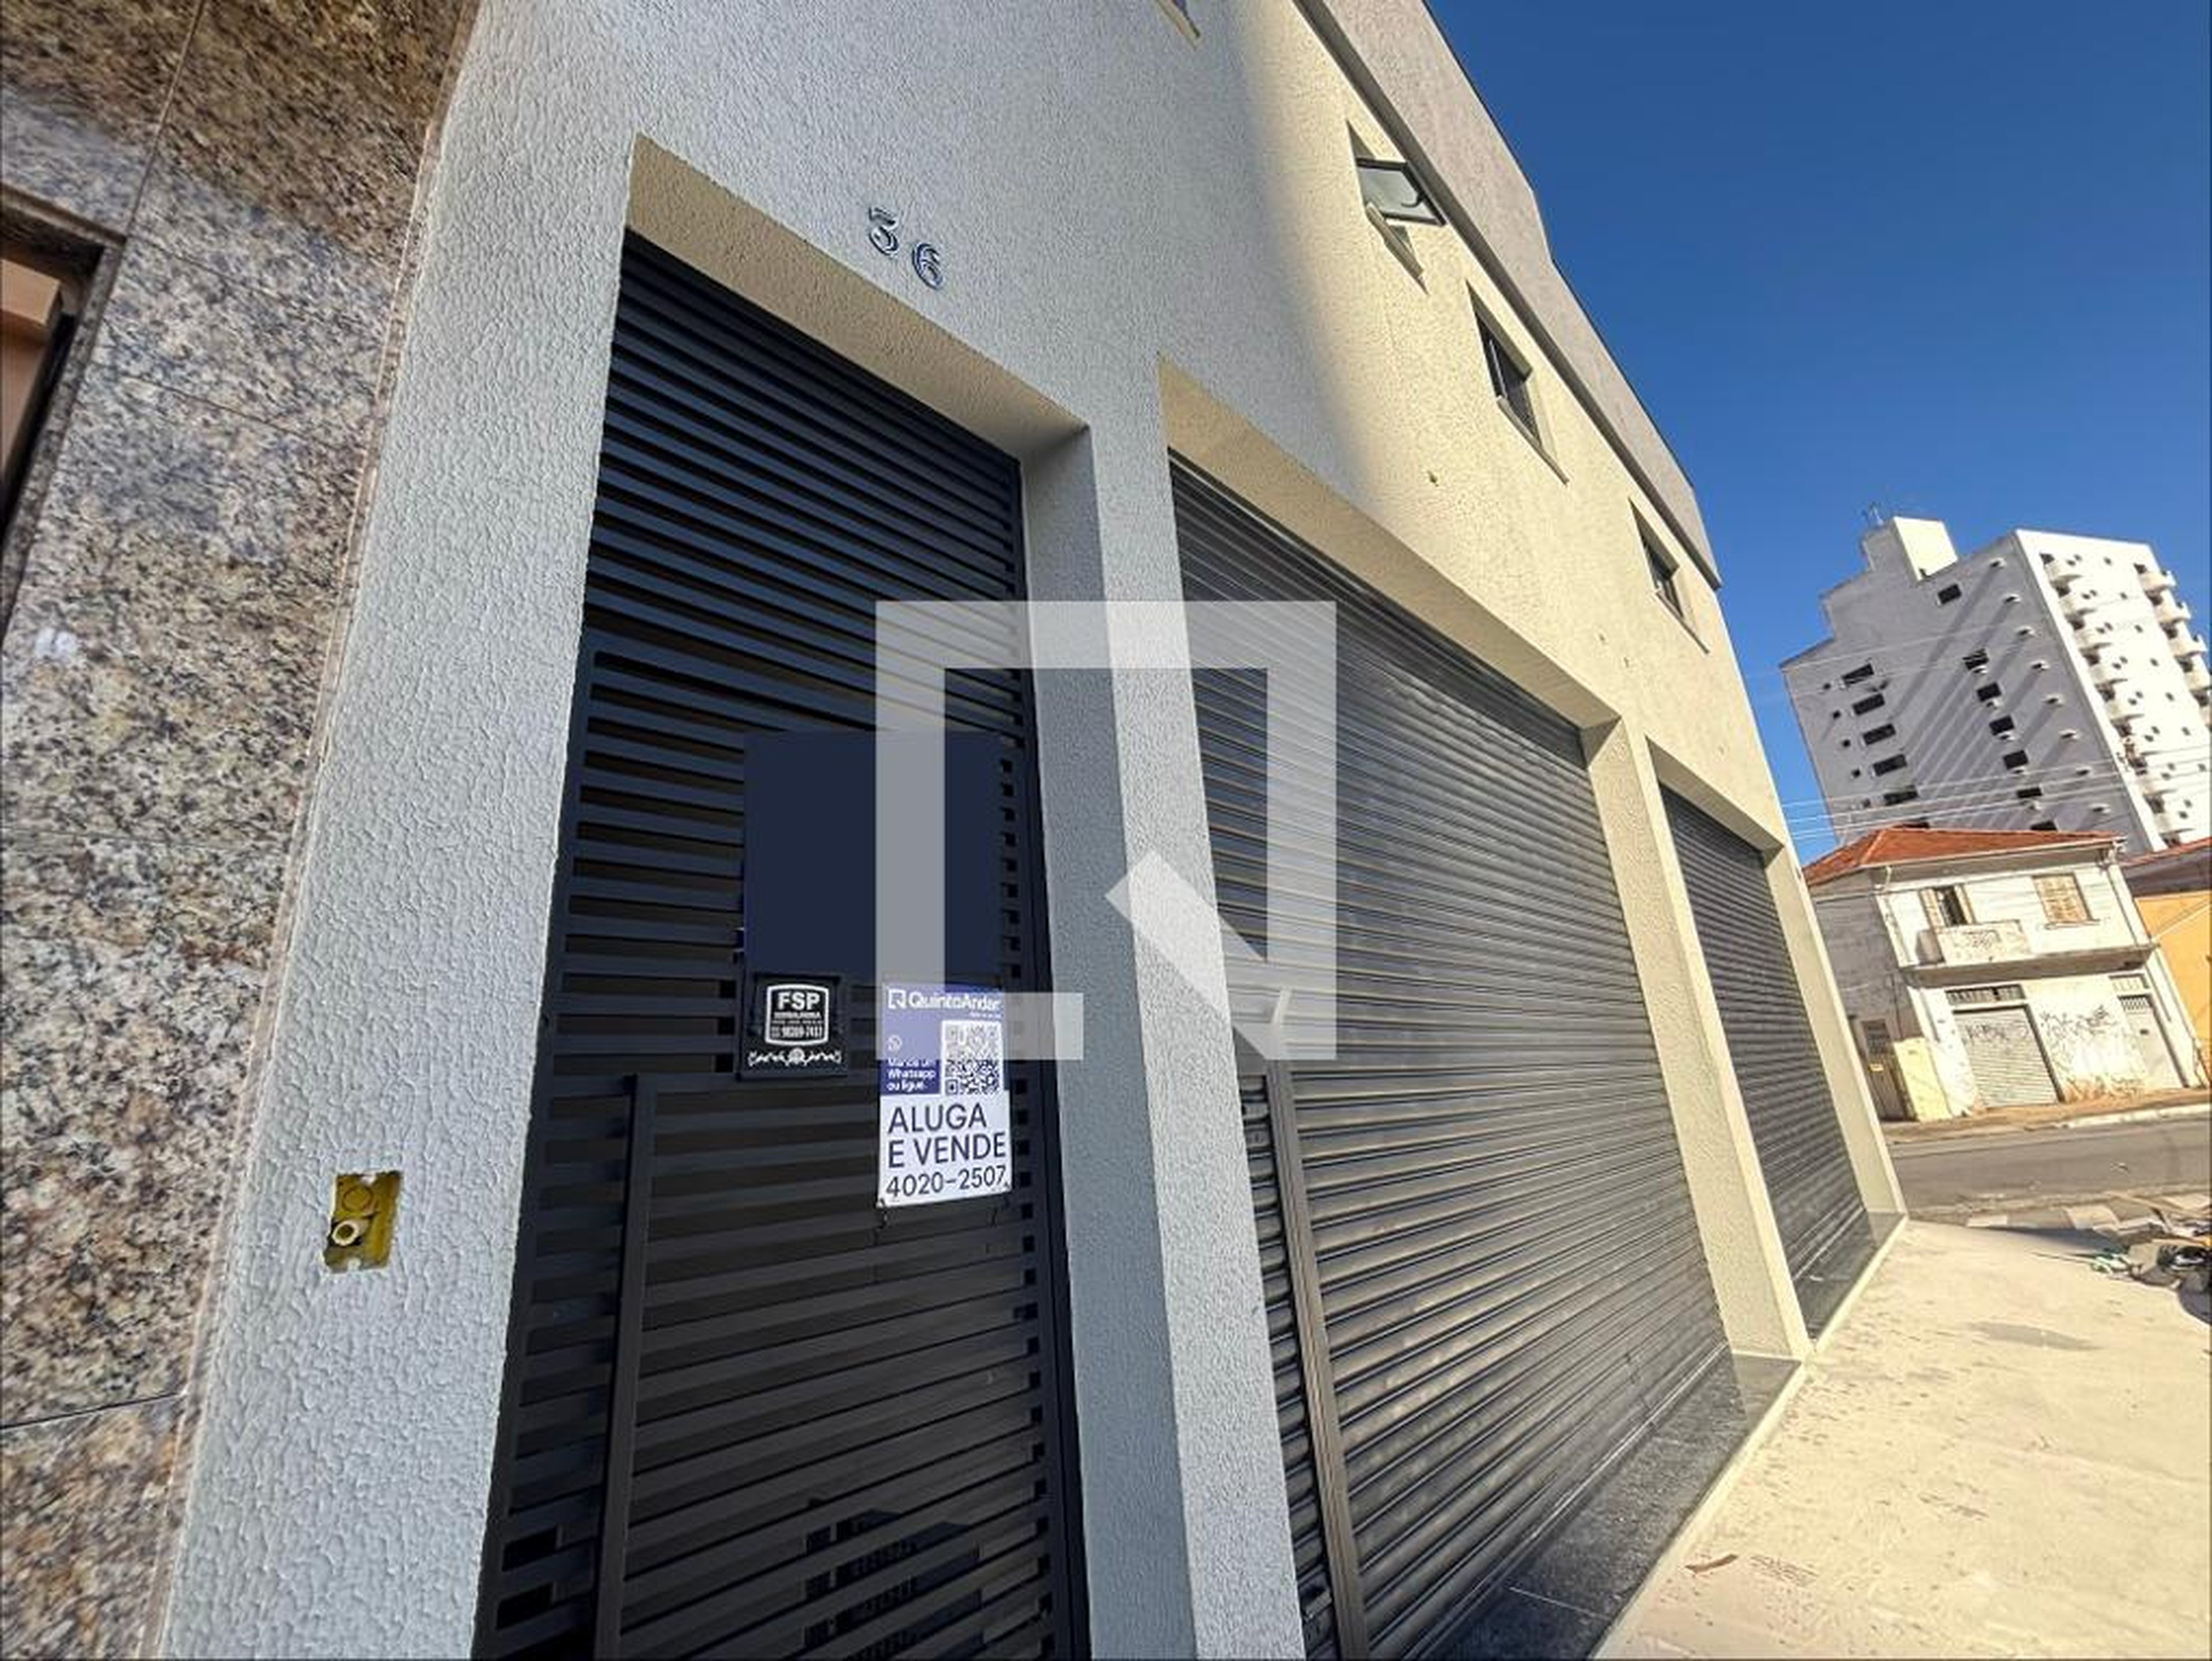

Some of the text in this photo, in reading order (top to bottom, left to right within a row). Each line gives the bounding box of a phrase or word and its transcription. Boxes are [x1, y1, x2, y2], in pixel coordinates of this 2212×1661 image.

[777, 992, 820, 1010] FSP
[908, 990, 1001, 1010] QuintoAndar
[888, 1103, 987, 1134] ALUGA
[889, 1132, 1006, 1168] E VENDE
[886, 1165, 1006, 1198] 4020-2507
